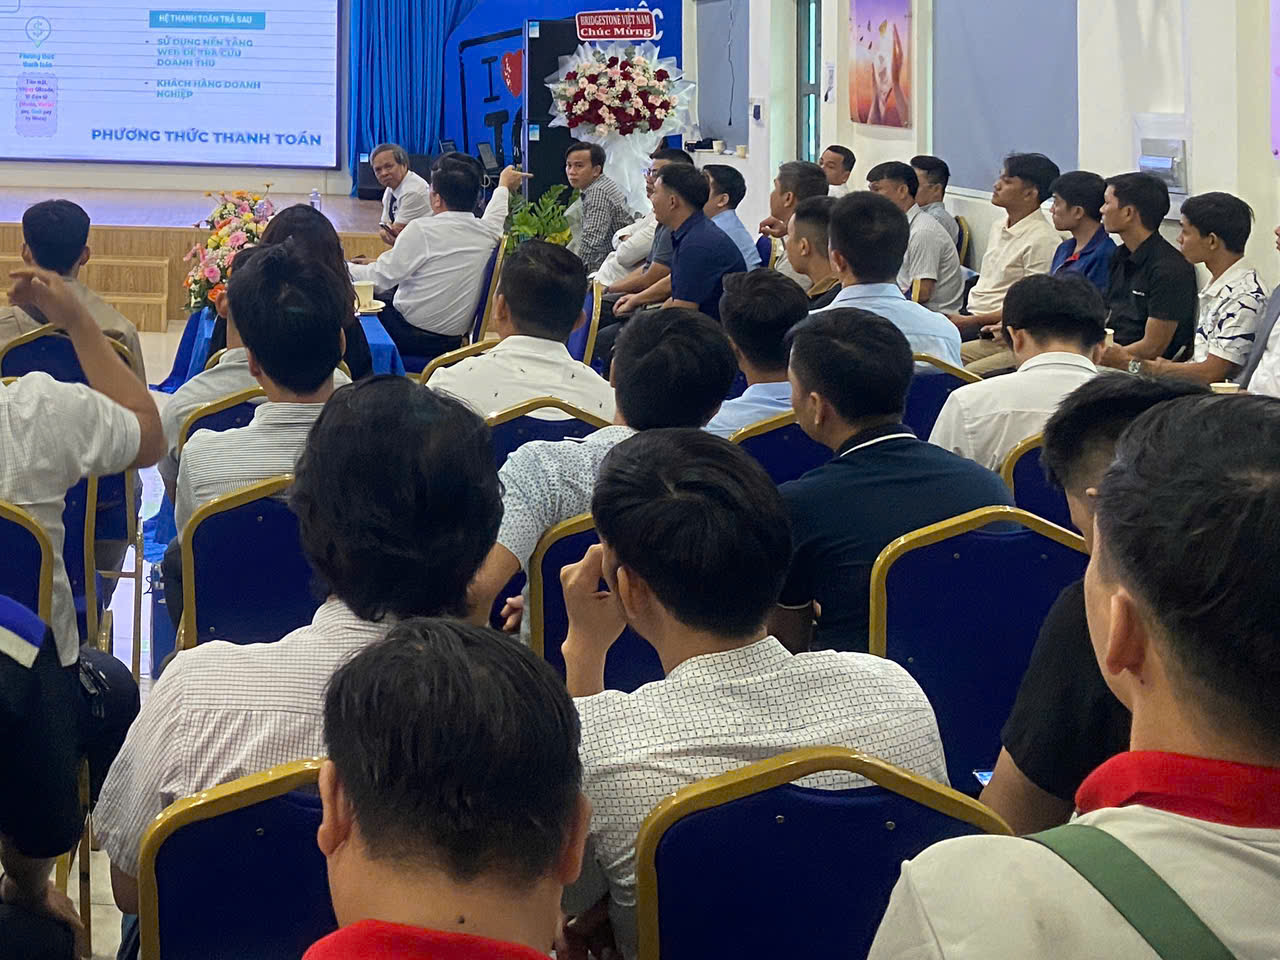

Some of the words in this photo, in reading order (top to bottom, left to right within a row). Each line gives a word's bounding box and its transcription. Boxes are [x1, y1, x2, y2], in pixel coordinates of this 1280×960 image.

[171, 14, 197, 23] THANH
[198, 14, 218, 23] TOÁN
[236, 16, 252, 24] SAU
[580, 14, 622, 26] BRIDGESTONE
[622, 12, 635, 26] VIỆT
[636, 14, 650, 25] NAM
[580, 27, 612, 36] Chúc
[614, 26, 652, 37] Mừng
[157, 58, 193, 66] DOANH
[196, 59, 216, 67] THU
[156, 78, 191, 88] KHÁCH
[224, 80, 261, 89] DOANH
[91, 127, 161, 142] PHƯƠNG
[164, 127, 209, 143] THỨC
[213, 131, 270, 144] THANH
[274, 130, 322, 146] TOÁN
